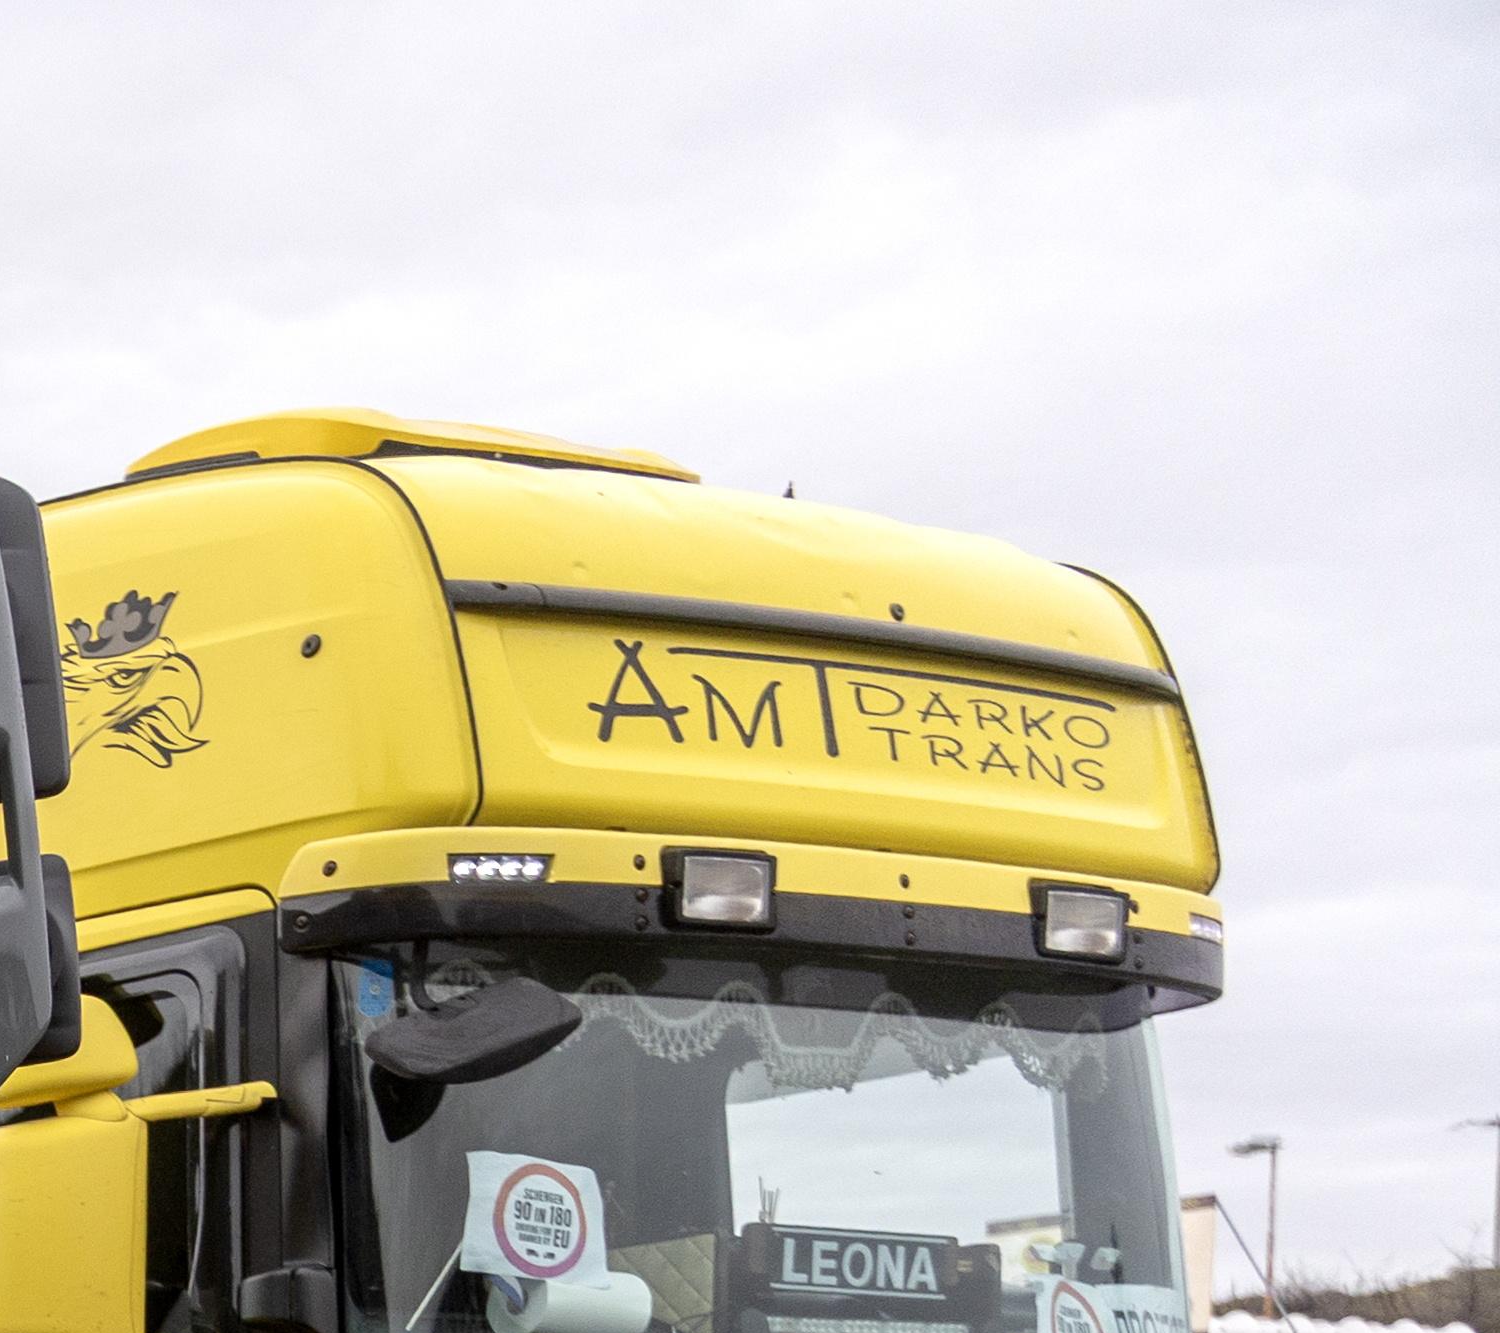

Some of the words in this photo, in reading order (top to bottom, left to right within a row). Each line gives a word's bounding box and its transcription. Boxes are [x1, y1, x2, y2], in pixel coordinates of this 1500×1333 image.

[847, 681, 1111, 749] DARKO
[868, 727, 1106, 792] TRANS
[514, 1200, 531, 1220] 90
[535, 1208, 546, 1223] IN
[550, 1206, 572, 1227] 180
[553, 1230, 571, 1248] EU
[781, 1237, 938, 1292] LEONA
